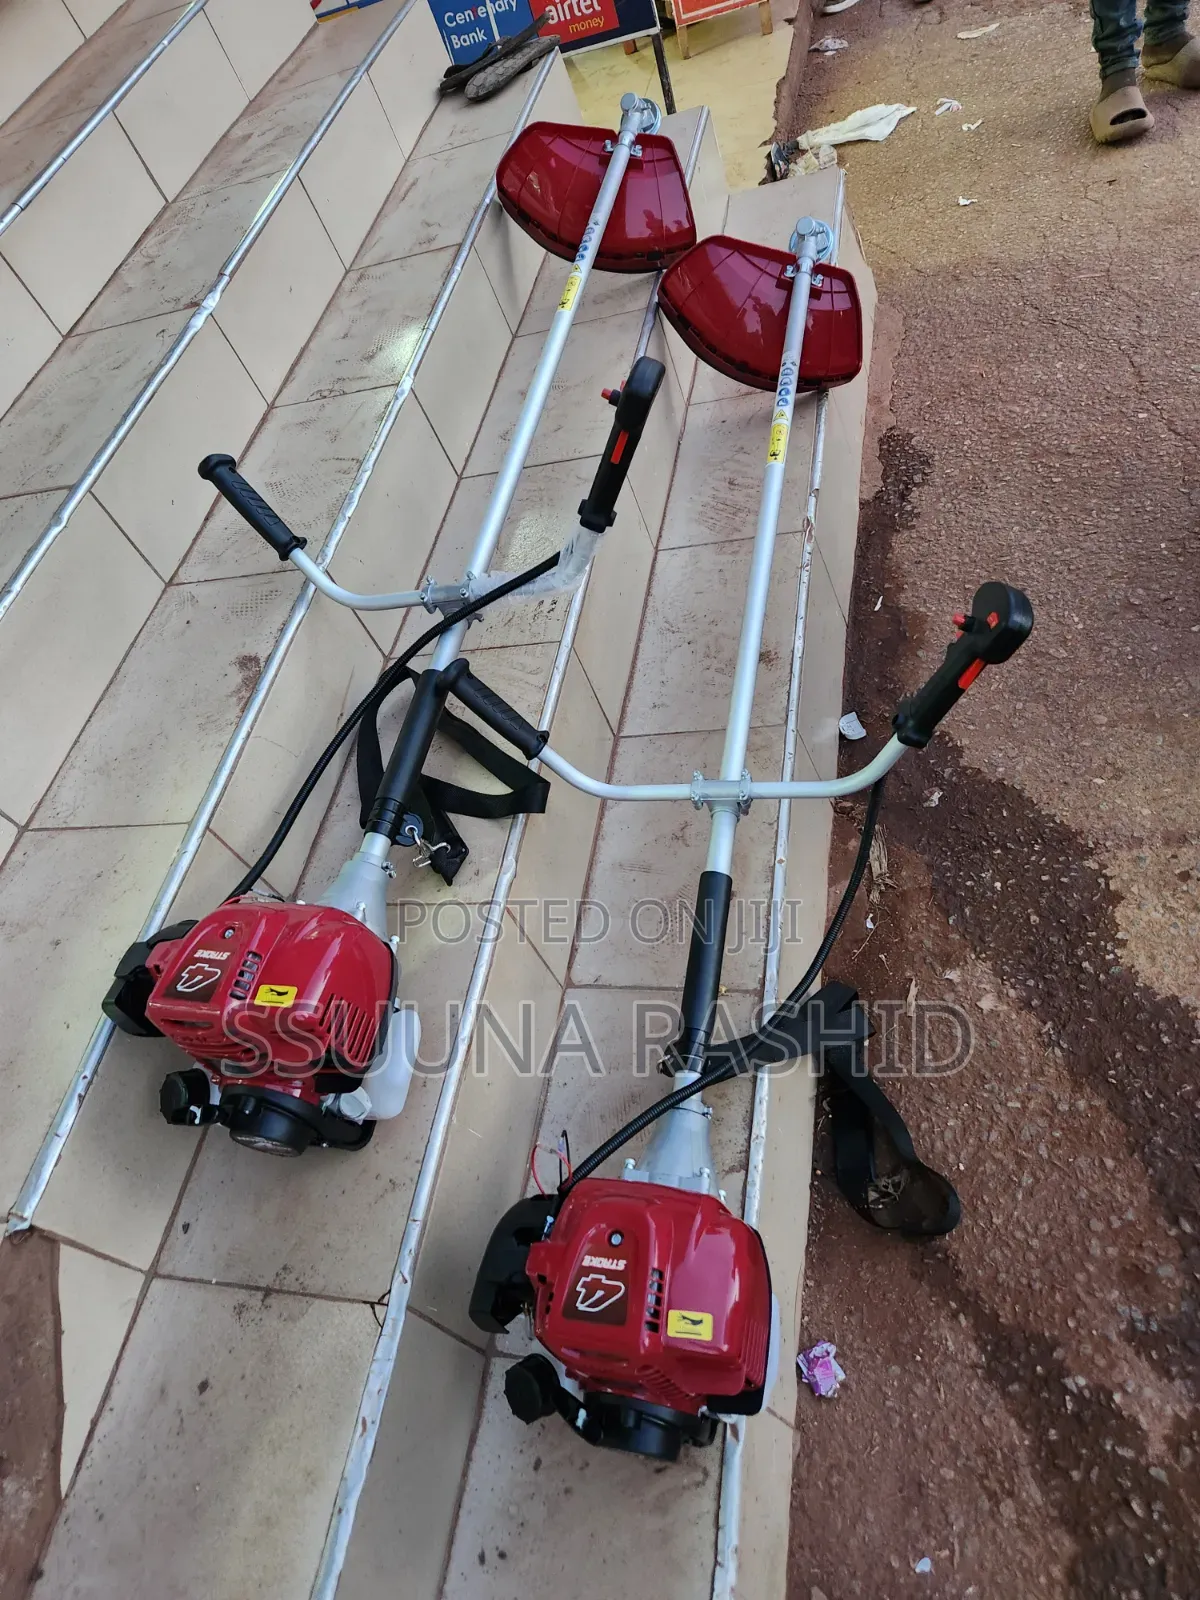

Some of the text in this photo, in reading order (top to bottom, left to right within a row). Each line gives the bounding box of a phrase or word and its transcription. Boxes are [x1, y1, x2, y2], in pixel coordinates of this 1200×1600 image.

[444, 0, 517, 27] Centenary
[568, 16, 605, 34] money
[451, 27, 488, 49] Bank
[194, 949, 231, 961] STROKE
[176, 963, 221, 992] 4
[581, 1255, 628, 1271] STROKE
[576, 1273, 626, 1312] 4
